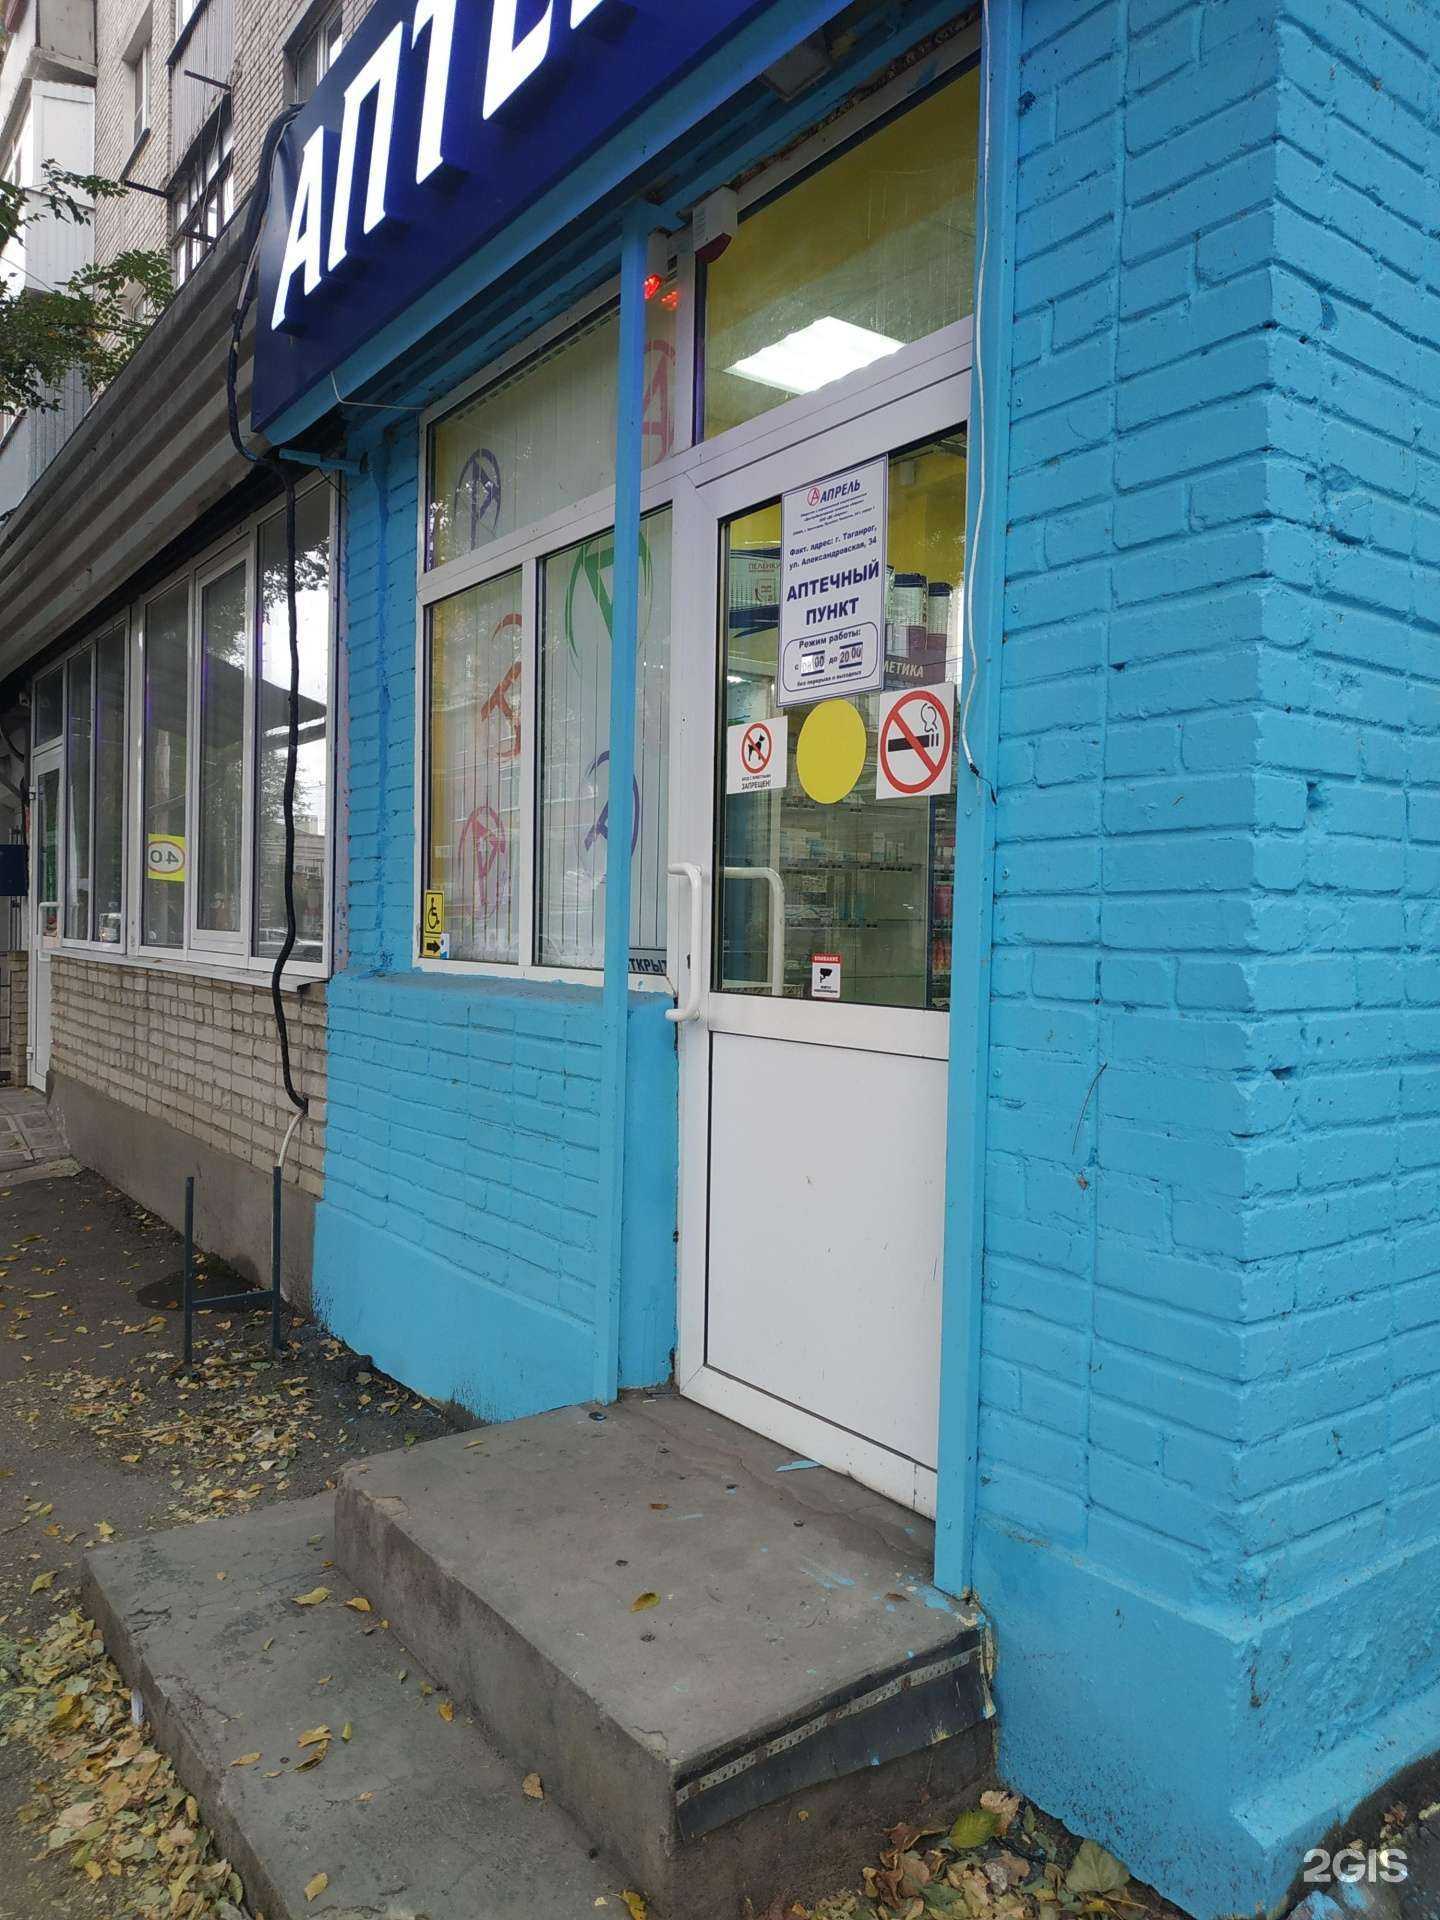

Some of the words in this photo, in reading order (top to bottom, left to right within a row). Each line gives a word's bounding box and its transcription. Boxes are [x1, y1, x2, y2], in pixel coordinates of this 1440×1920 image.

[820, 479, 861, 503] АПРЕЛЬ
[789, 546, 809, 557] Факт.
[810, 540, 834, 552] адрес:
[842, 525, 877, 541] Таганрог,
[789, 561, 800, 571] ул.
[801, 542, 867, 567] Александровская,
[868, 536, 877, 546] 34
[786, 558, 880, 602] АПТЕЧНЫЙ
[805, 597, 860, 626] ПУНКТ
[798, 637, 827, 649] Режим
[828, 629, 861, 644] работы:
[828, 656, 838, 665] до
[839, 650, 850, 664] 20
[628, 958, 667, 973] ТКРЫТ
